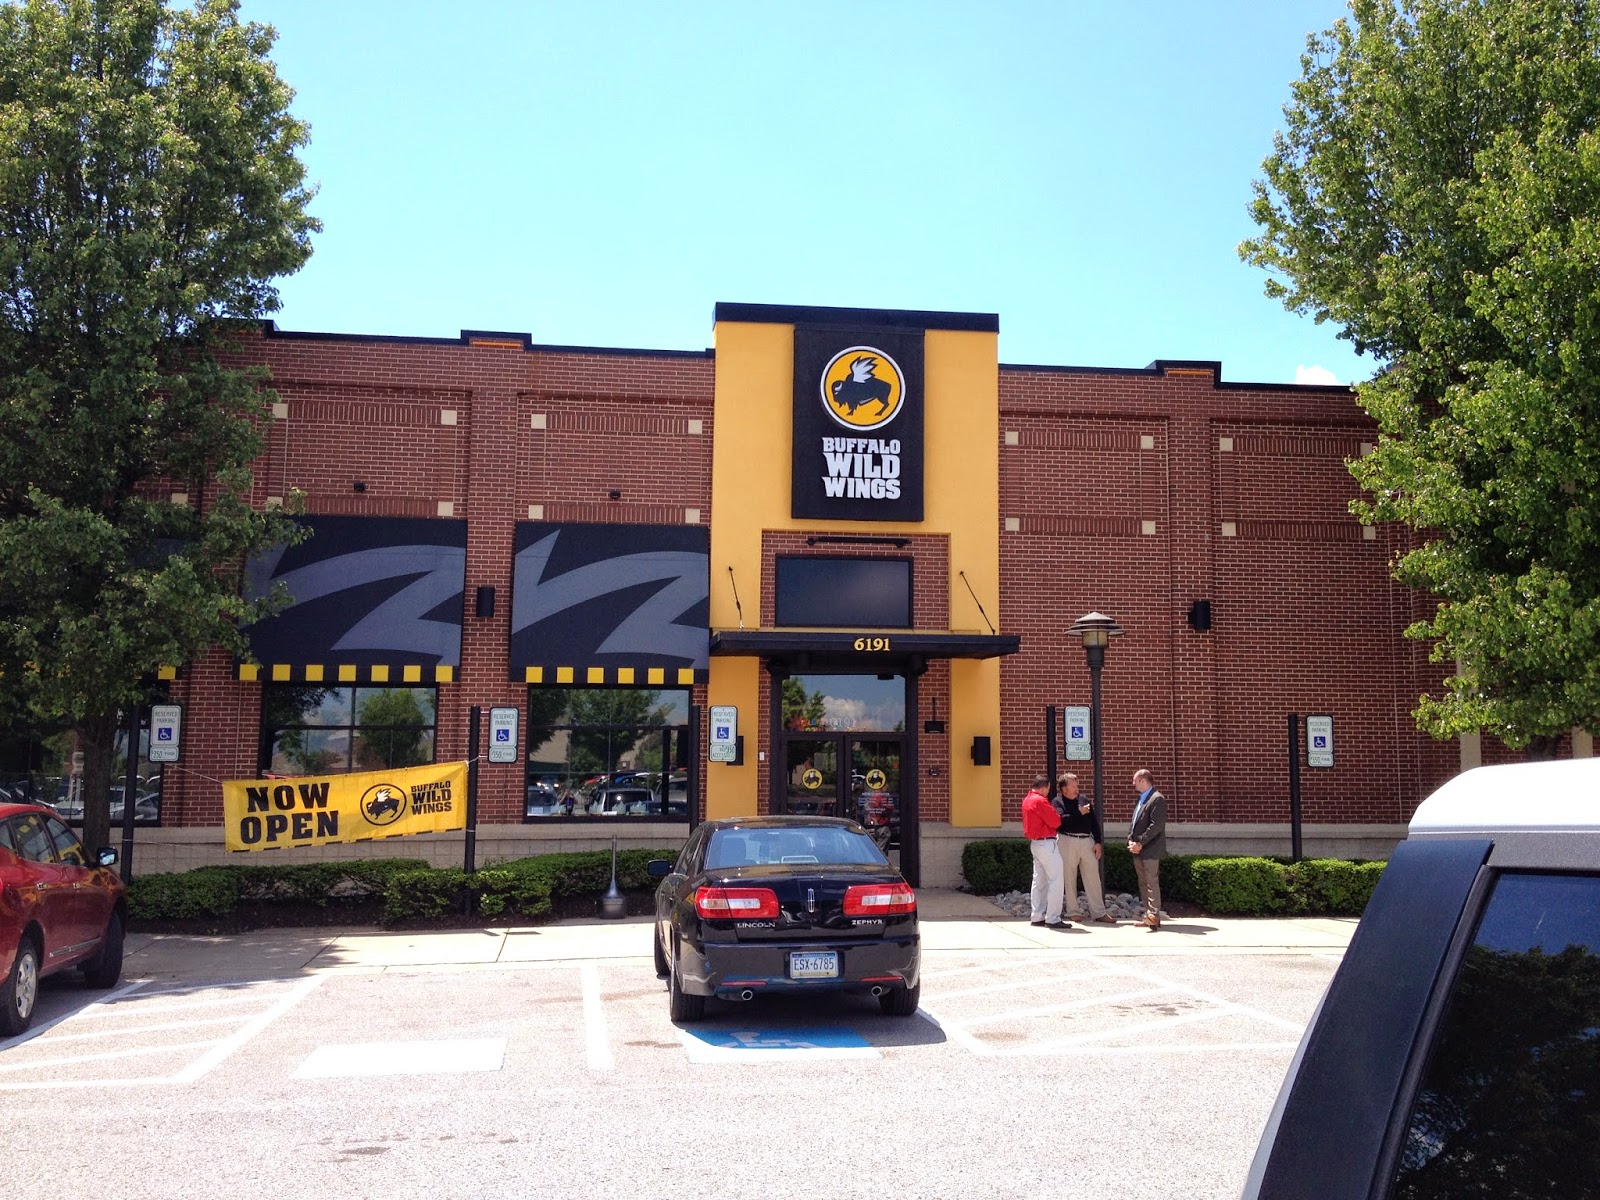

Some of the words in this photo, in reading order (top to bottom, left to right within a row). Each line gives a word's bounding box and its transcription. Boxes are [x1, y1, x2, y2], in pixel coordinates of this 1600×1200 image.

[822, 437, 901, 454] BUFFALO
[823, 452, 901, 479] WILD
[821, 477, 901, 499] WINGS
[854, 637, 890, 651] 6191
[410, 780, 451, 792] BUFFALO
[245, 782, 330, 813] NOW
[411, 788, 452, 805] WILD
[411, 801, 452, 816] WINGS
[240, 810, 339, 845] OPEN
